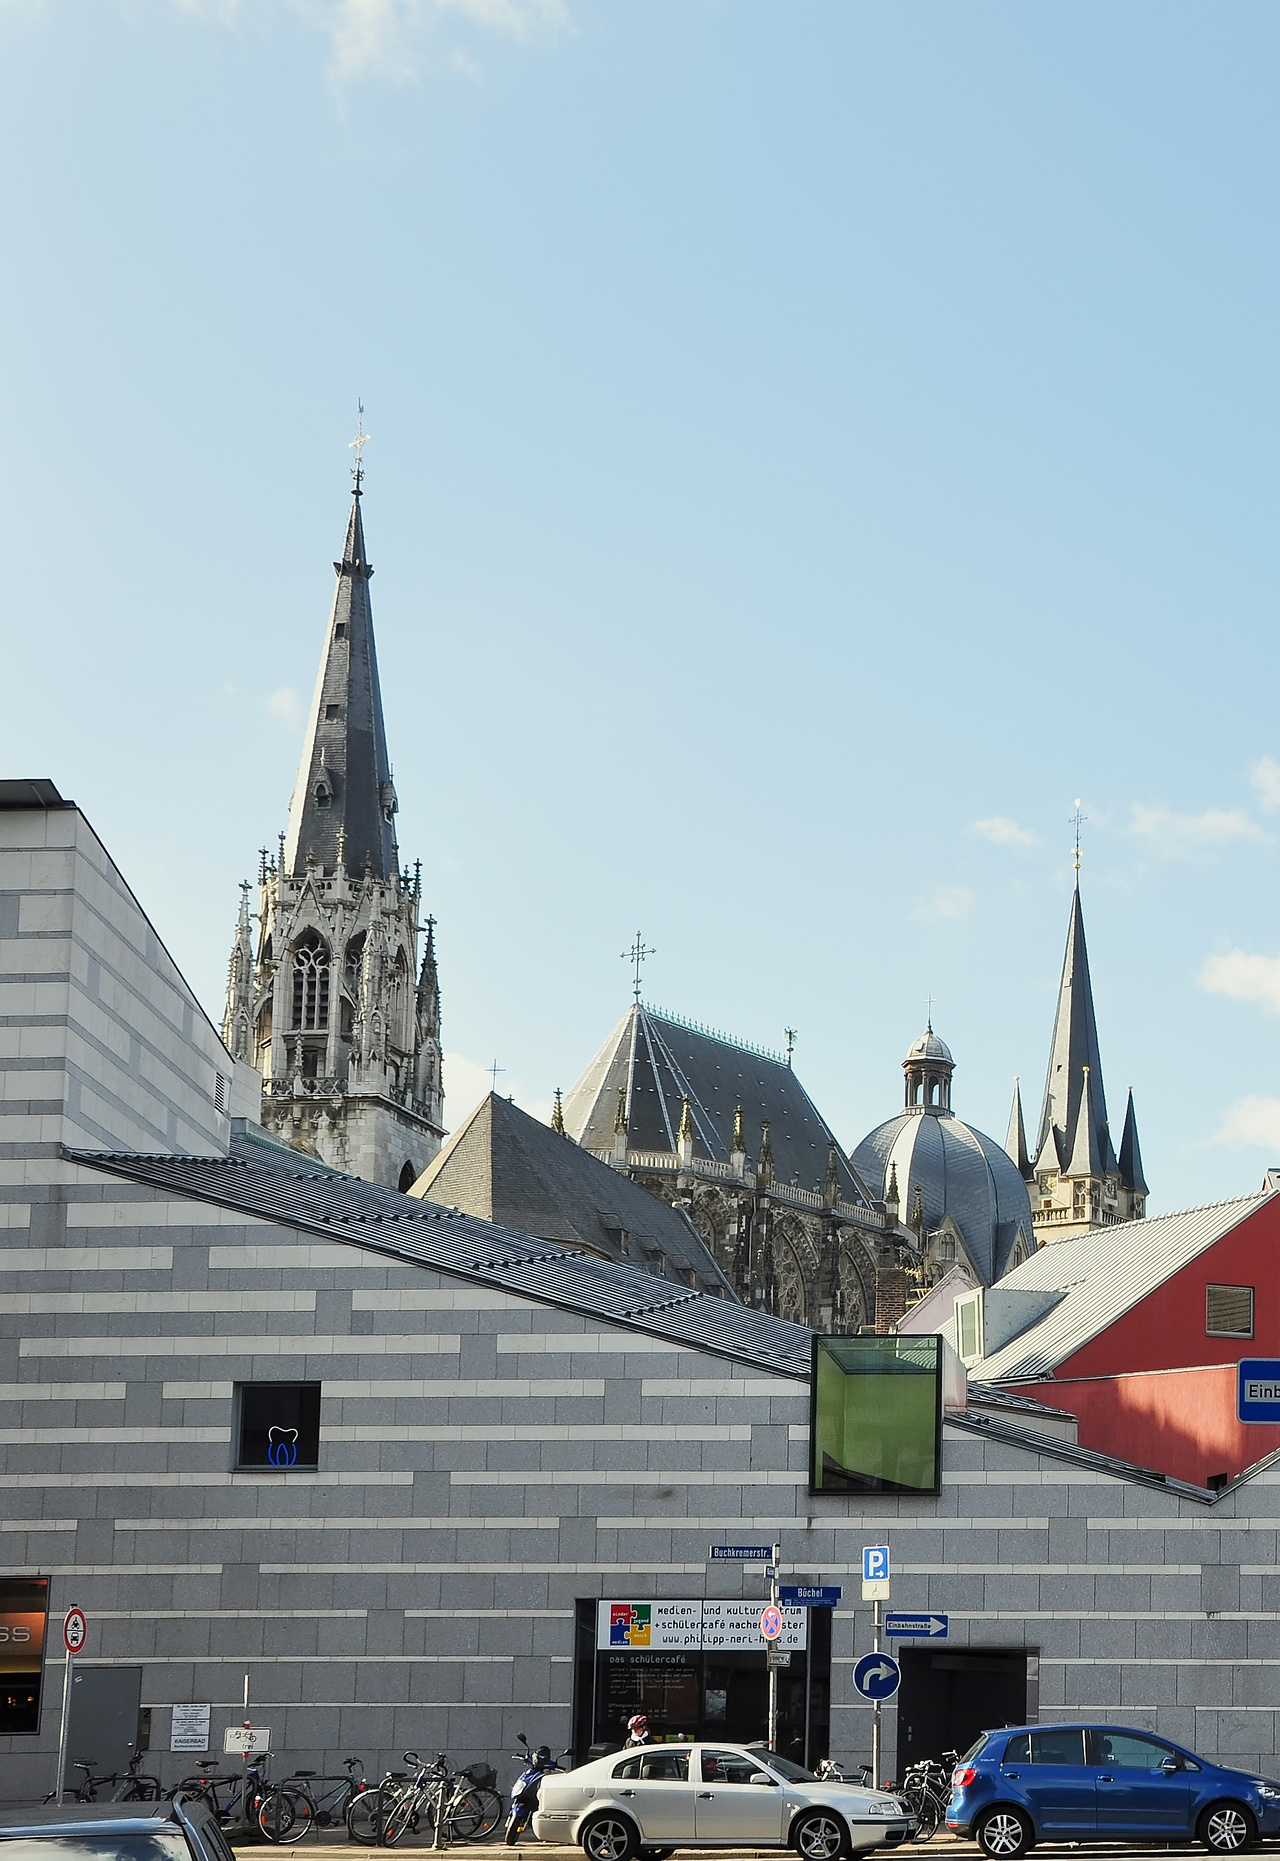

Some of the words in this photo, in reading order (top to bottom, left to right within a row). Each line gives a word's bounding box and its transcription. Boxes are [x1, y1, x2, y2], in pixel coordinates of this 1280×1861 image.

[714, 1547, 770, 1558] Buchkremerstr.
[868, 1550, 884, 1577] P
[797, 1587, 823, 1598] Büchel
[703, 1605, 721, 1615] und
[662, 1633, 799, 1646] www.philipp-neri-hs.de
[609, 1655, 625, 1664] Das
[629, 1654, 686, 1664] schülercafé
[143, 1709, 151, 1719] 2
